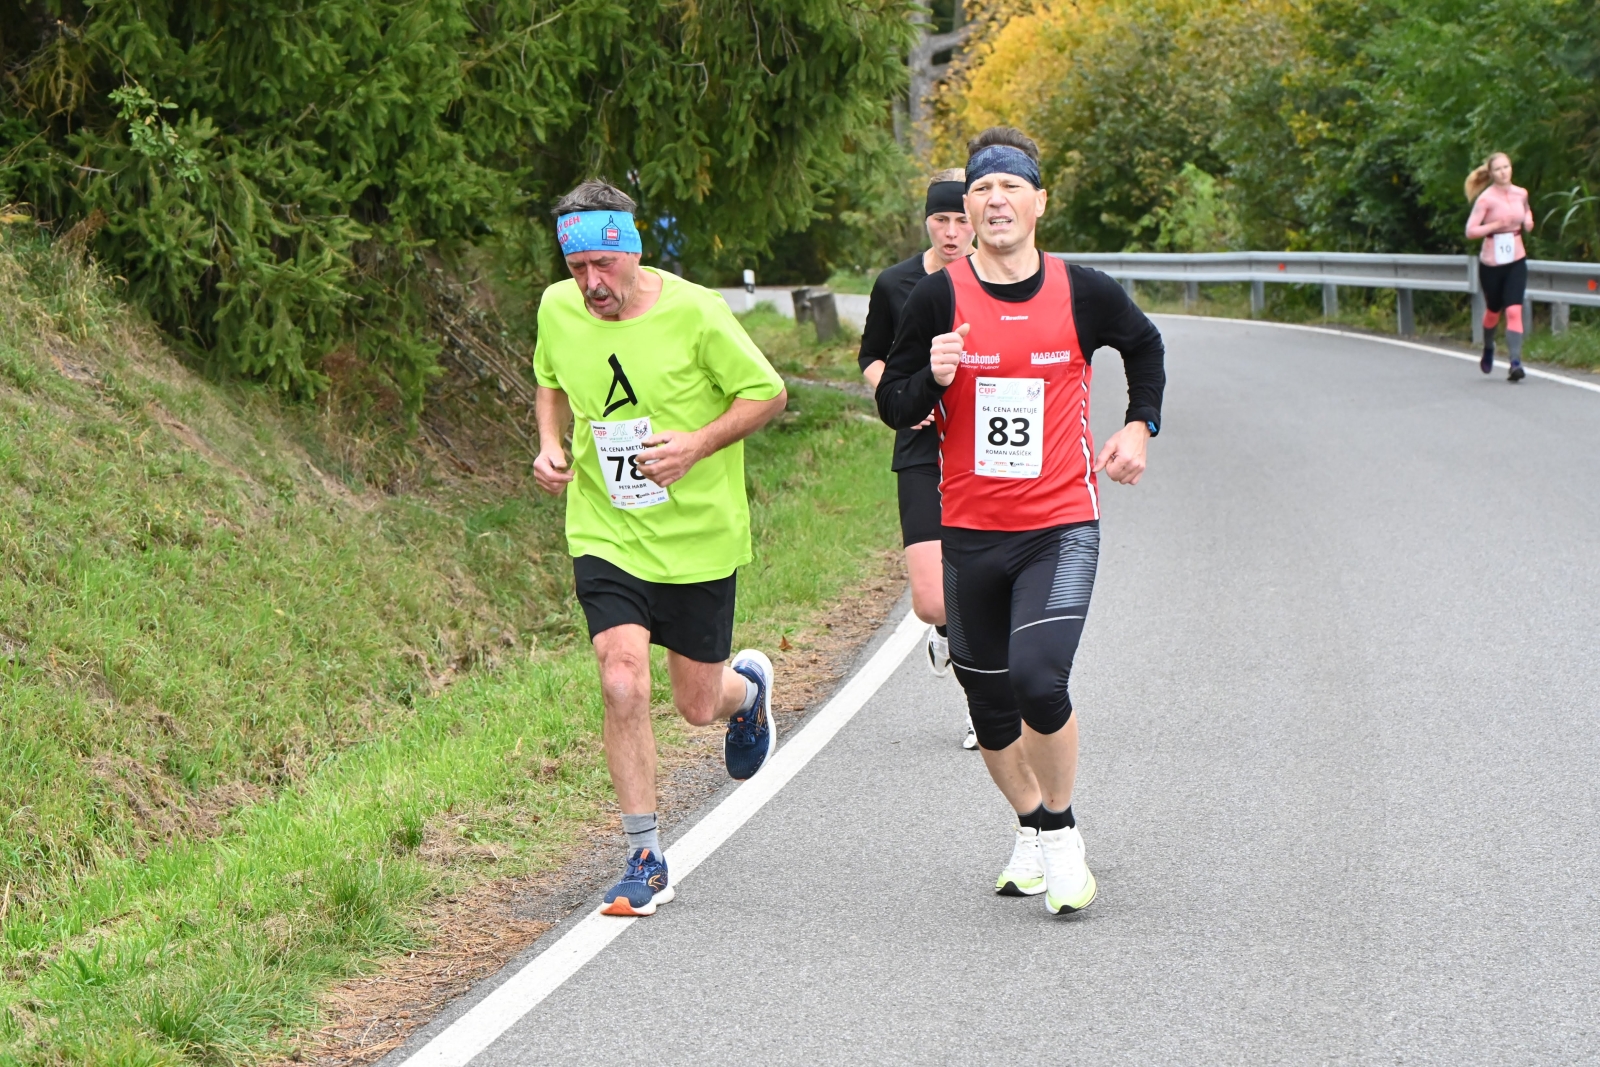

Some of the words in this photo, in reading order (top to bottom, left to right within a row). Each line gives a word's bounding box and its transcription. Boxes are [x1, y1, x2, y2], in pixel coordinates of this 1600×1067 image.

[563, 215, 581, 228] BĚH
[1499, 245, 1512, 253] 10
[960, 351, 1000, 365] Krakonoš
[1031, 350, 1070, 360] MARATON
[982, 405, 992, 413] 64.
[987, 416, 1030, 447] 83
[625, 444, 646, 452] METUJ
